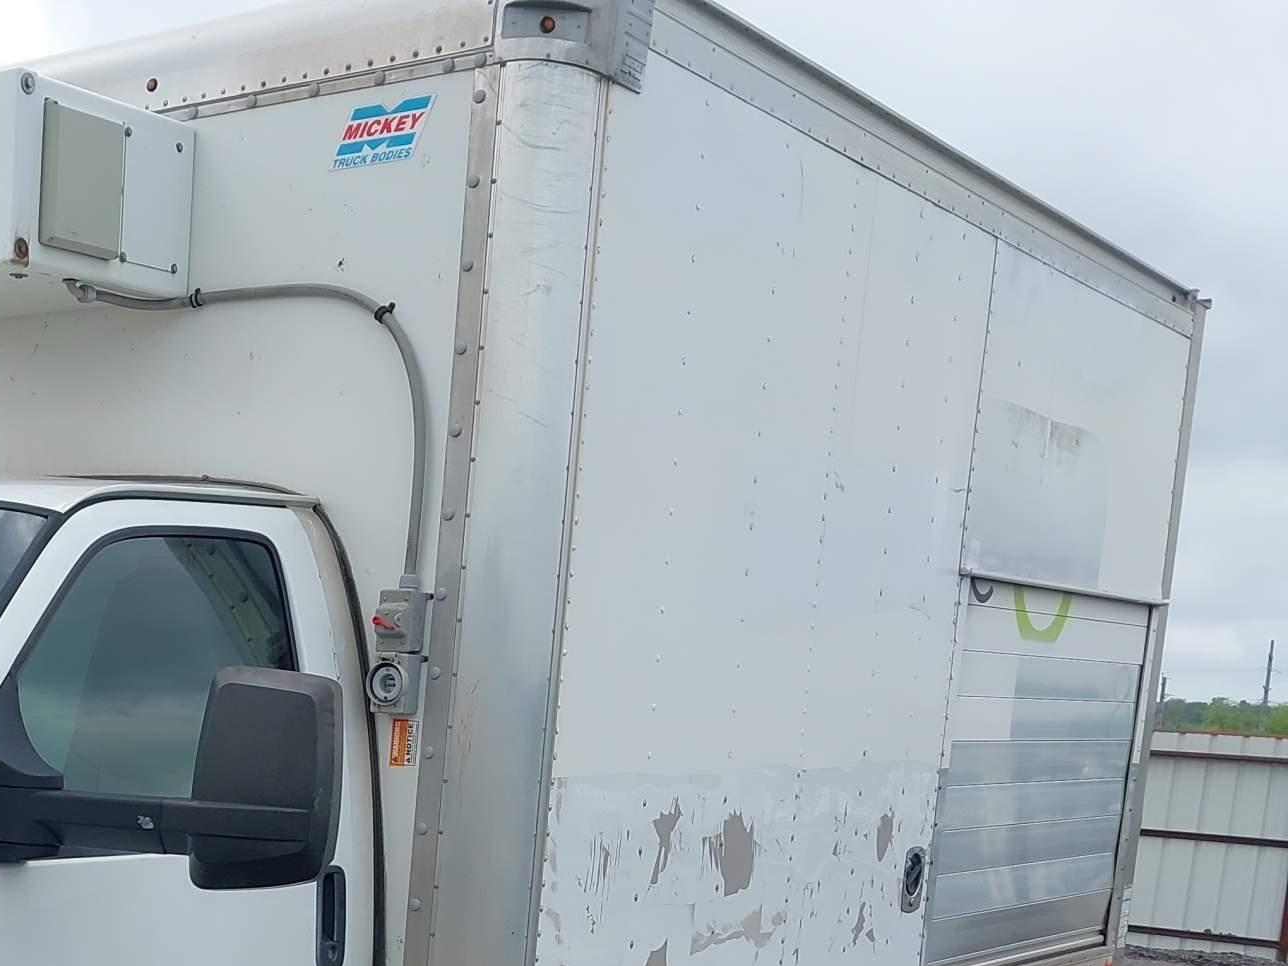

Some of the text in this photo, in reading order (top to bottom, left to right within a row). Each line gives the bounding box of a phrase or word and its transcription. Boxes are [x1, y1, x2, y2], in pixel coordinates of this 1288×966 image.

[342, 111, 426, 141] MICKEY
[332, 147, 413, 169] TRUCK BODIES
